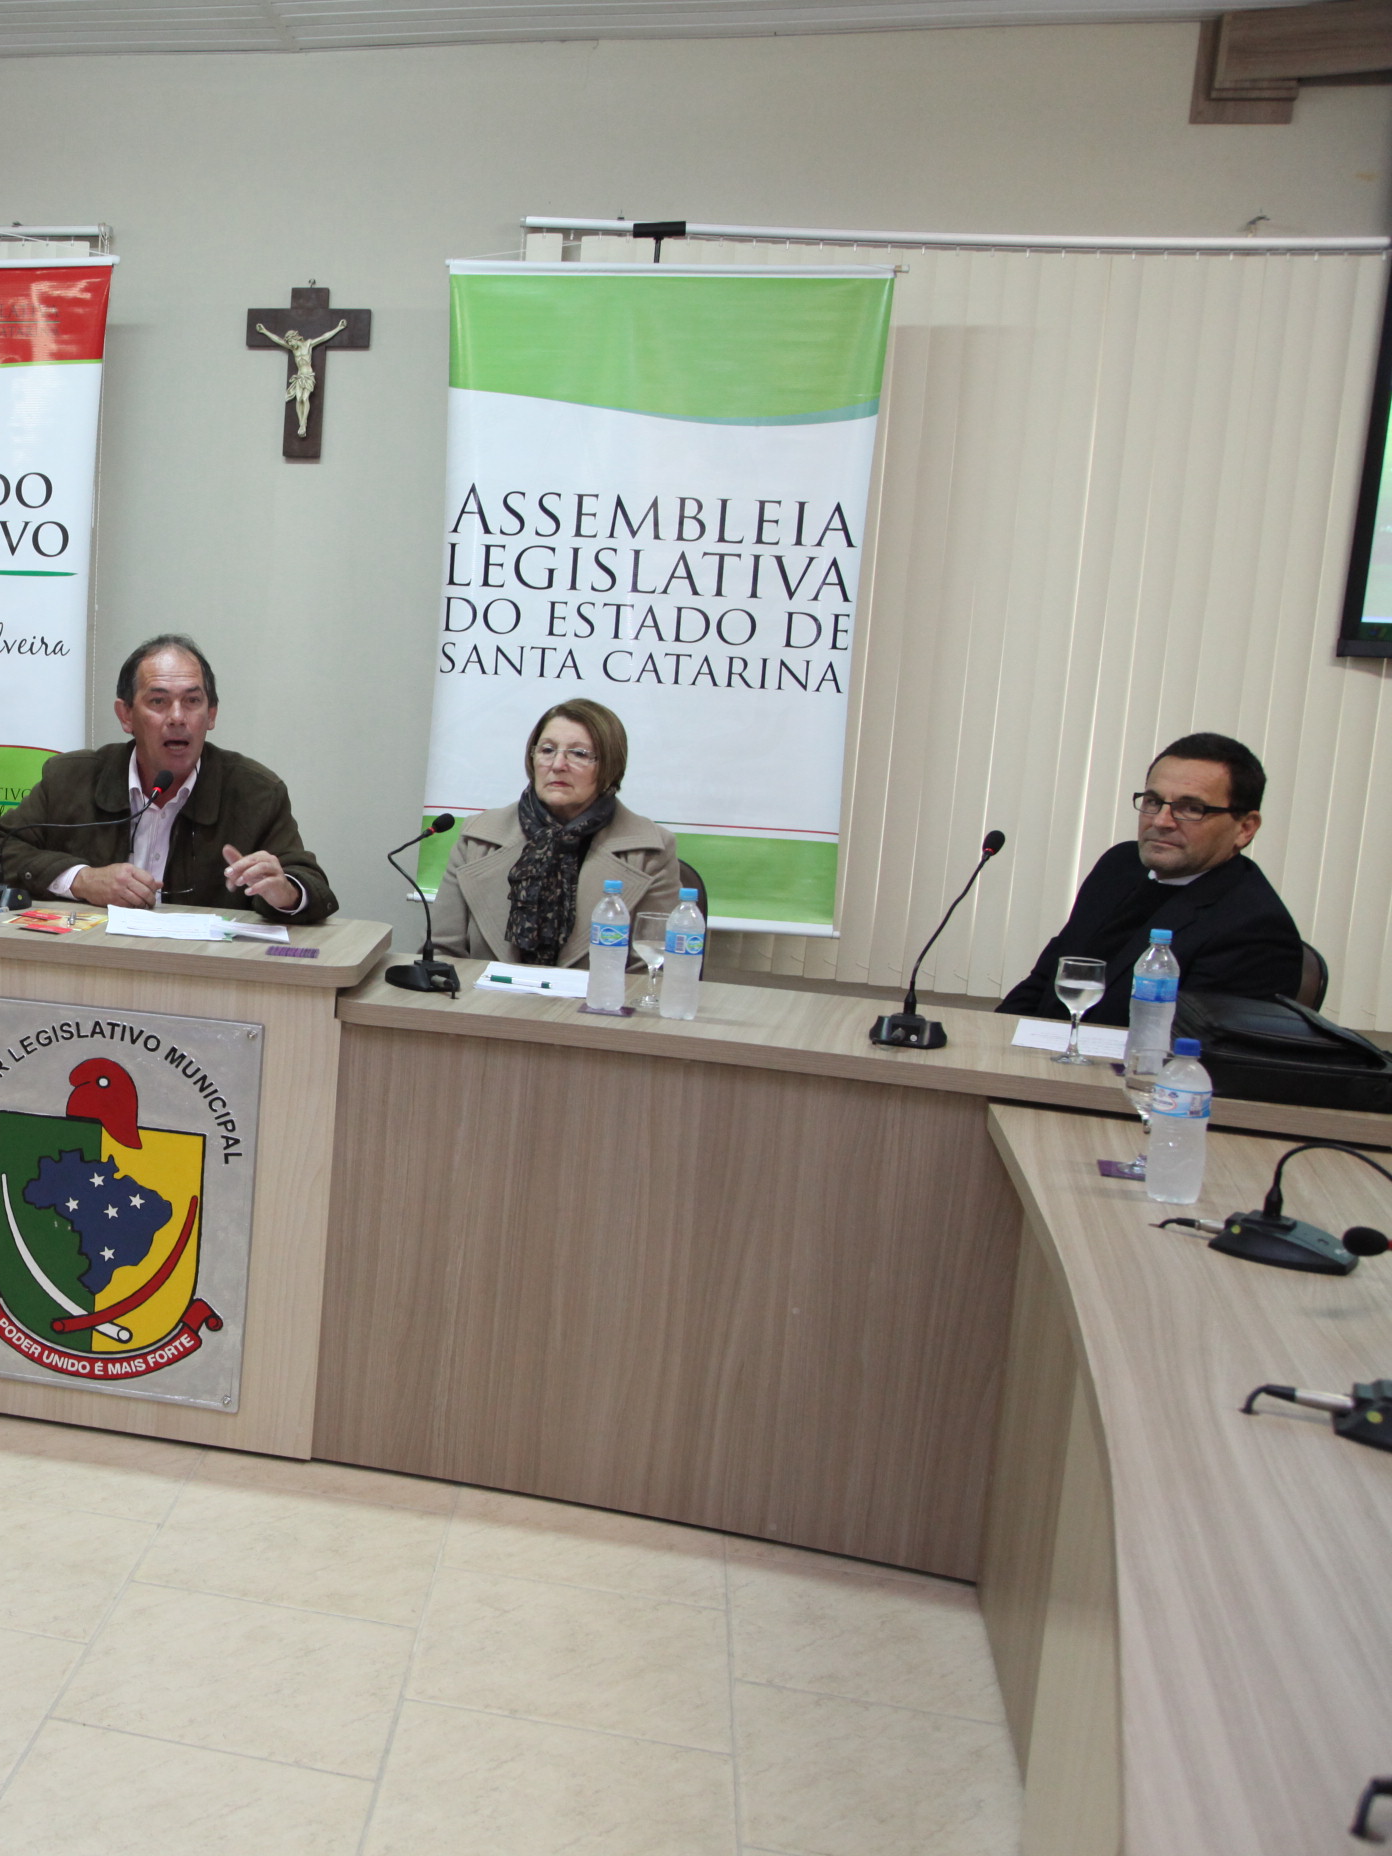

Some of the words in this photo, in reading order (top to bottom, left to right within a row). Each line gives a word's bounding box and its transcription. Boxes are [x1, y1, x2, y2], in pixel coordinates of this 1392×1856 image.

[448, 482, 858, 549] ASSEMBLEIA
[446, 542, 853, 603] LEGISLATIVA
[442, 596, 521, 634] DO
[545, 600, 757, 646] ESTADO
[782, 610, 851, 651] DE
[439, 642, 585, 680] SANTA
[601, 649, 844, 694] CATARINA
[8, 1020, 161, 1063] LEGISLATIVO
[164, 1045, 243, 1164] MUNICIPAL
[42, 1352, 90, 1374] UNIDO
[94, 1359, 104, 1375] É
[108, 1358, 146, 1375] MAIS
[147, 1333, 195, 1367] FORTE
